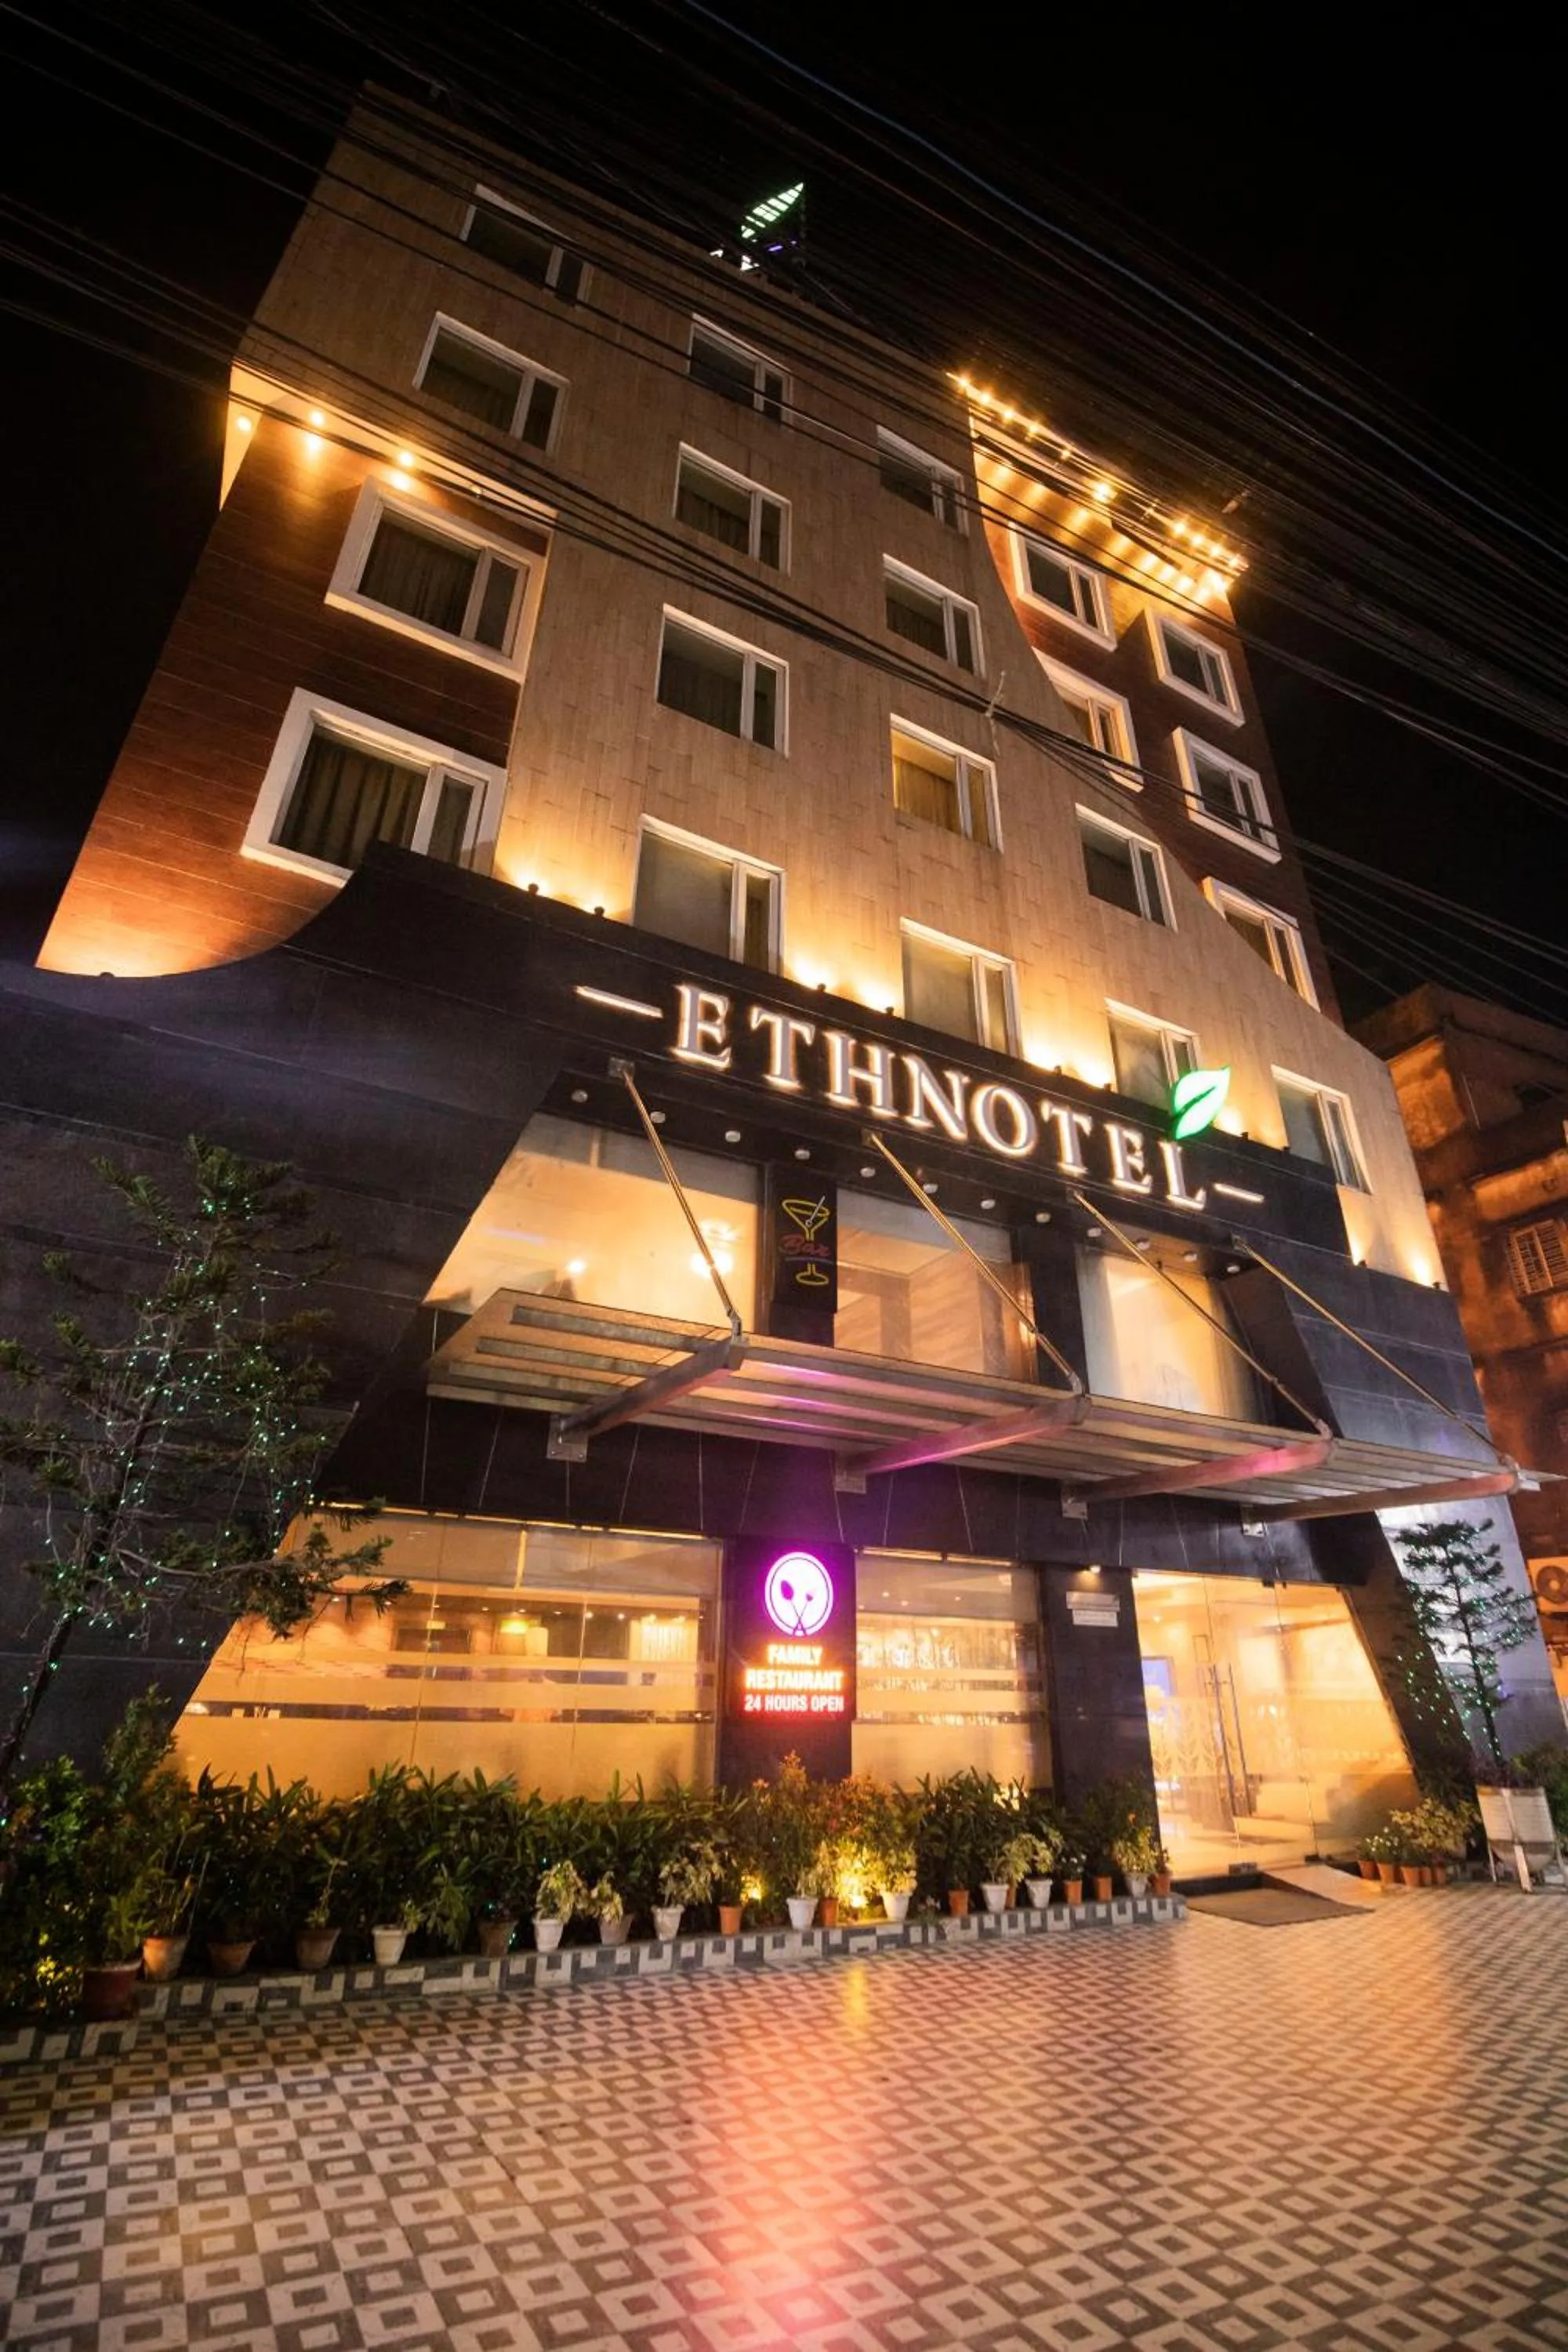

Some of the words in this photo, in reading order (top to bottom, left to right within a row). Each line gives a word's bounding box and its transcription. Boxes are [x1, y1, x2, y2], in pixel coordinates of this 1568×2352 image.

[670, 984, 1207, 1211] ETHNOTEL
[778, 1233, 831, 1258] Bar
[768, 1644, 822, 1665] FAMILY
[746, 1669, 844, 1691] RESTAURANT
[745, 1695, 761, 1711] 24
[765, 1695, 808, 1711] HOURS
[811, 1695, 844, 1712] OPEN
